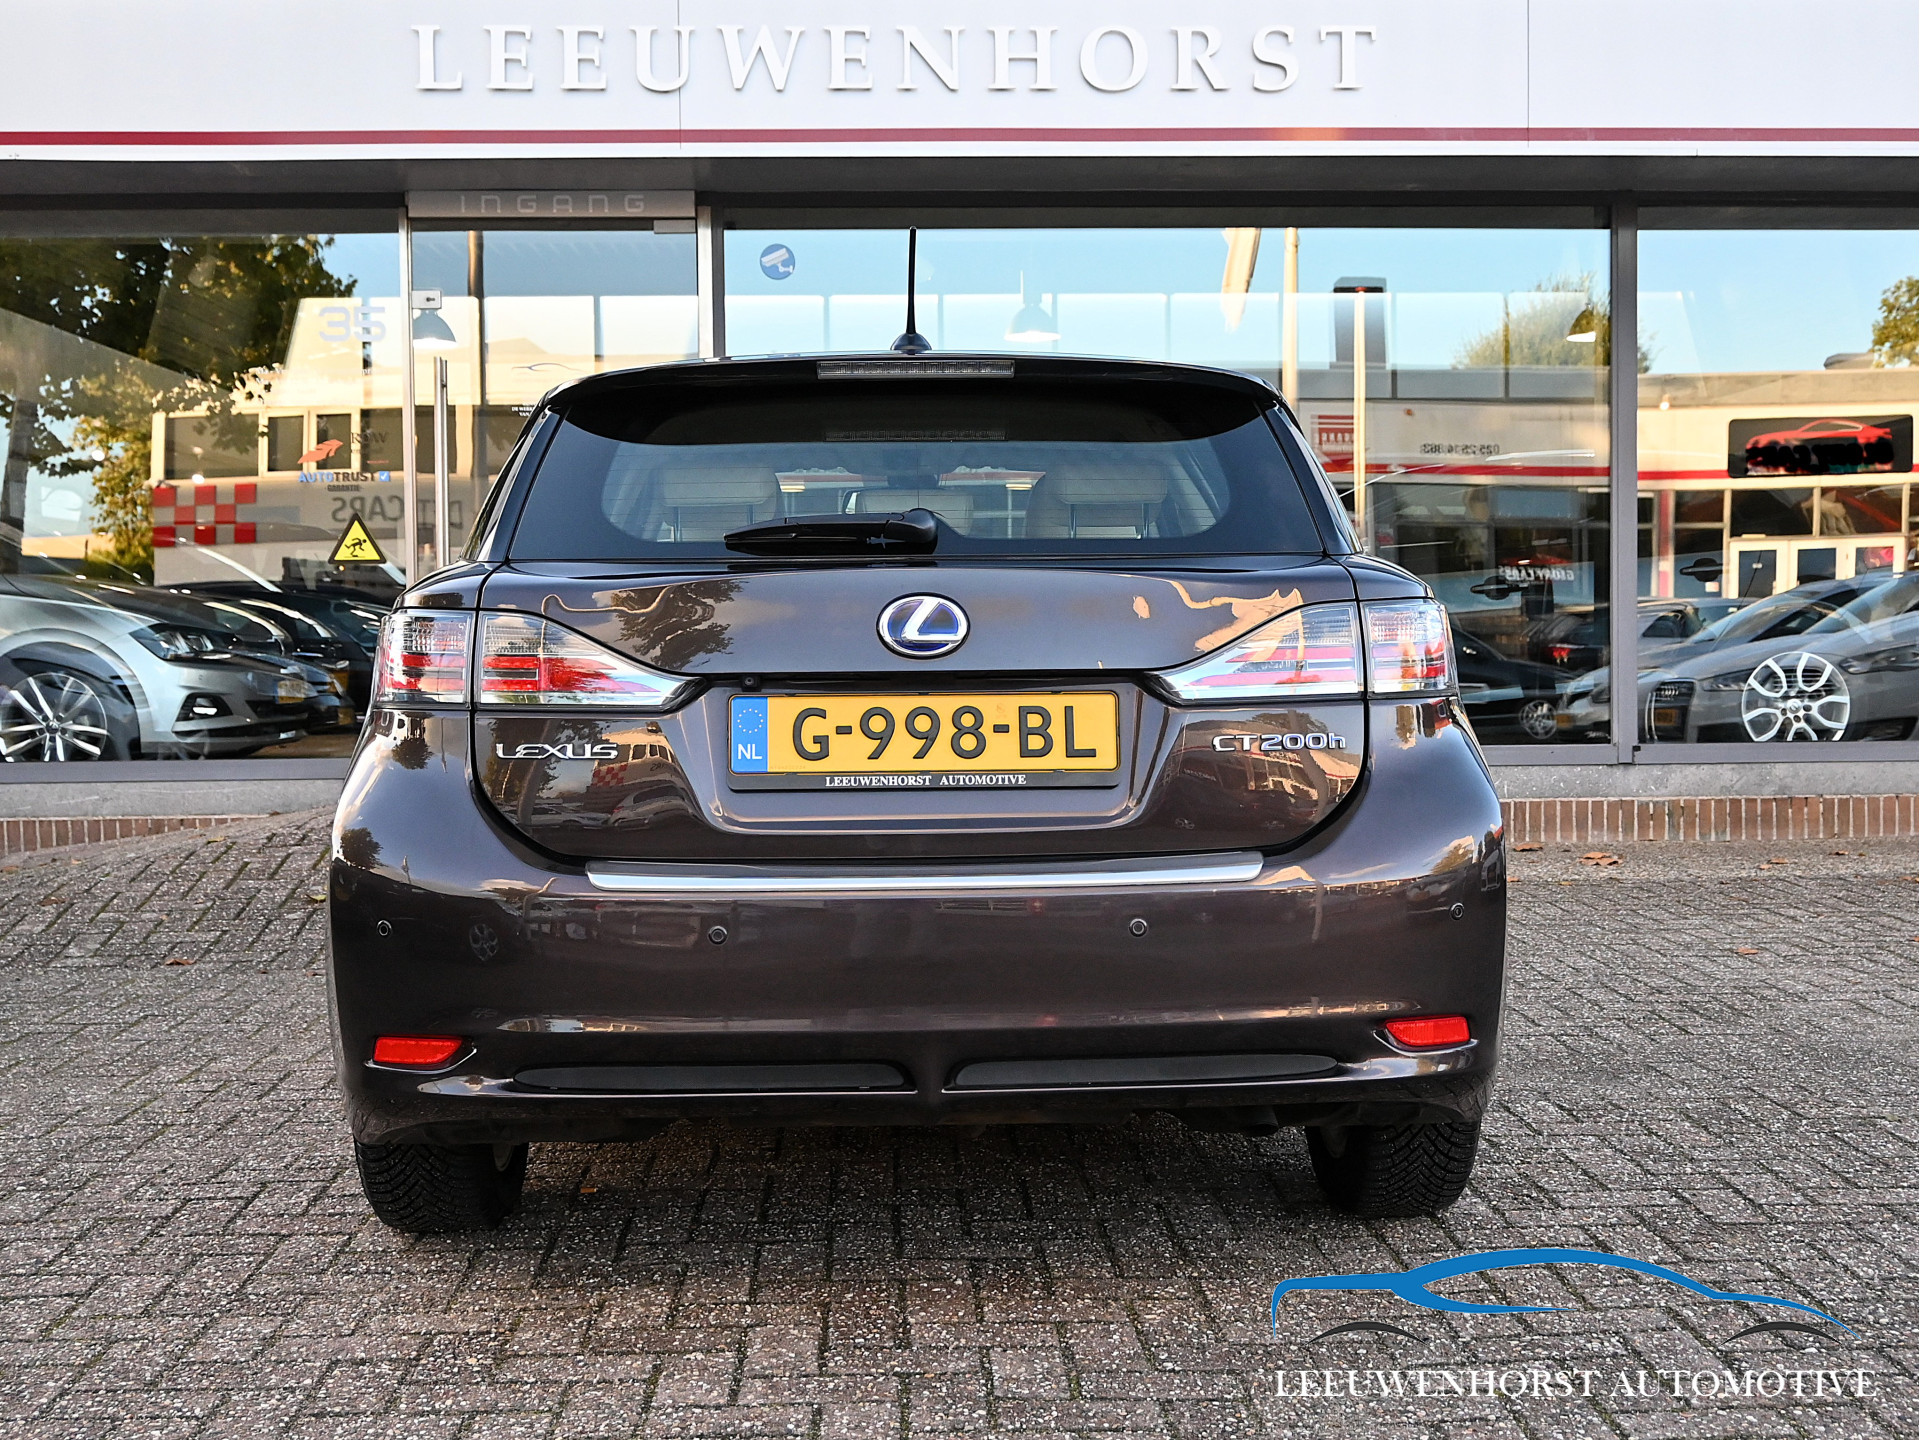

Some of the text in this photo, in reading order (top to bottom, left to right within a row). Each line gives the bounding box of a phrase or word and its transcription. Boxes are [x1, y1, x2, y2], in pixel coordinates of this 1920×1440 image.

[412, 24, 1378, 94] LEEUWENHORST
[460, 194, 646, 214] INGANG
[318, 306, 387, 343] 35
[298, 472, 376, 483] AUTOTRUST
[792, 705, 1097, 761] G-998-BL
[1212, 732, 1347, 752] CT200h
[496, 742, 619, 760] LEXUS
[737, 743, 763, 760] NL
[825, 774, 1027, 787] LEEUWENHORST AUTOMOTIVE
